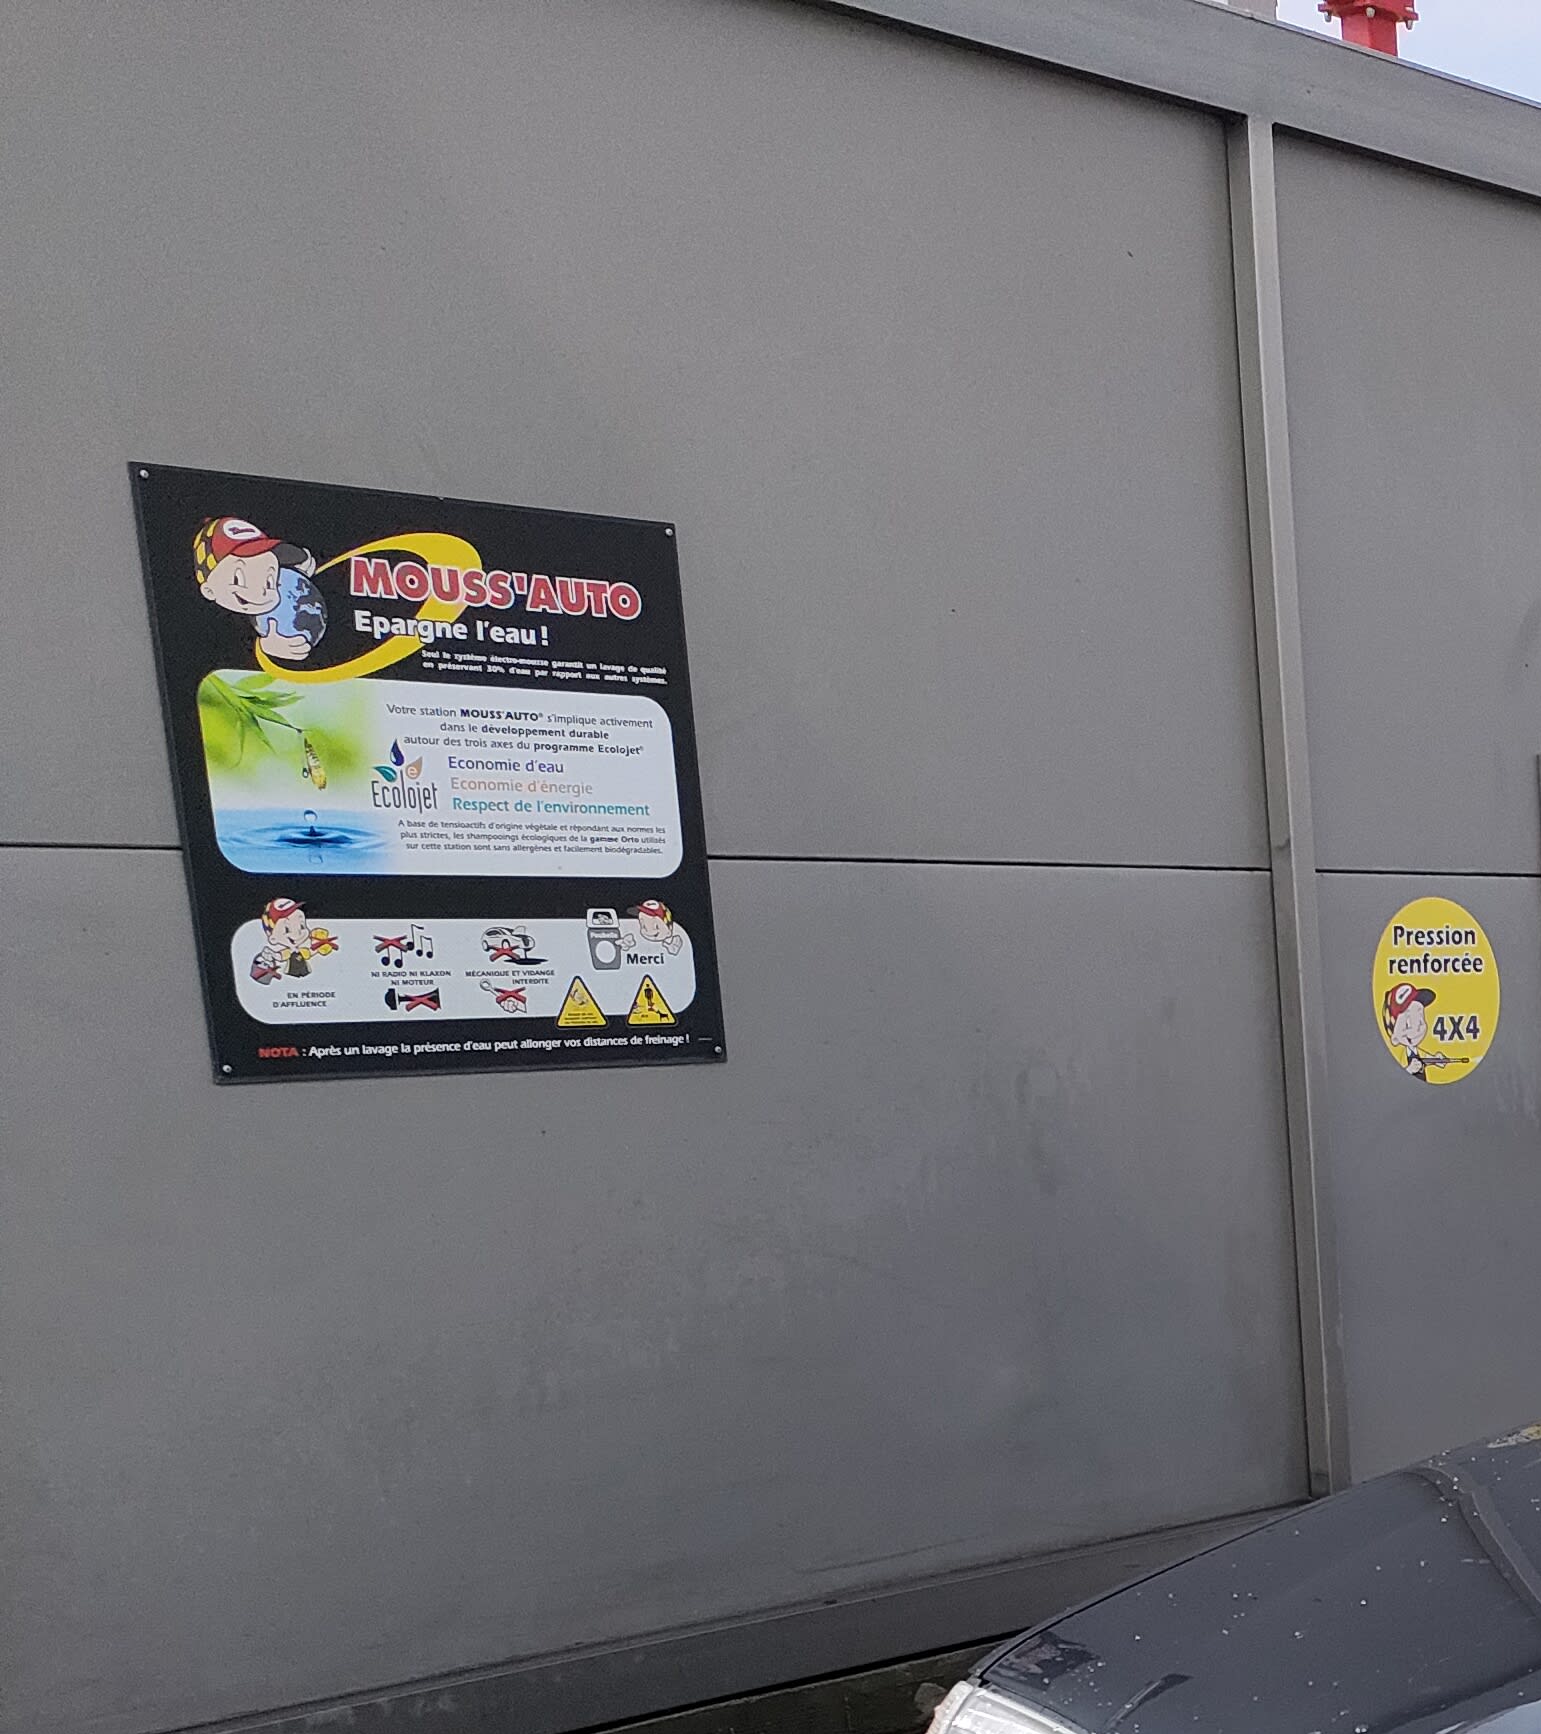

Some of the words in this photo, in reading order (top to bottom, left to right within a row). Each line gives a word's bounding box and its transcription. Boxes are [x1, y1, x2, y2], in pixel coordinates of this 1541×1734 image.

[350, 556, 642, 620] MOUSS'AUTO
[354, 609, 468, 644] Epargne
[552, 670, 582, 679] rapport
[600, 662, 625, 672] lavage
[386, 704, 416, 715] Votre
[420, 706, 456, 717] station
[547, 714, 597, 726] s'implique
[600, 716, 653, 728] activement
[440, 722, 465, 732] dans
[468, 724, 478, 732] le
[482, 724, 565, 738] développement
[569, 729, 609, 740] durable
[404, 736, 440, 745] autour
[443, 736, 460, 746] des
[464, 737, 488, 748] trois
[490, 740, 514, 749] axes
[516, 740, 530, 750] du
[534, 742, 594, 753] programme
[448, 756, 520, 772] Economie
[526, 758, 564, 773] d'eau
[371, 769, 438, 814] Ecolojet
[450, 776, 523, 792] Economie
[528, 780, 593, 796] d'énergie
[452, 797, 510, 814] Respect
[514, 799, 533, 812] de
[537, 800, 650, 816] l'environnement
[406, 820, 426, 828] base
[428, 820, 438, 828] de
[488, 822, 522, 832] d'origine
[570, 824, 608, 833] répondant
[400, 831, 417, 840] plus
[453, 832, 464, 840] les
[521, 834, 566, 843] écologiques
[569, 834, 578, 842] de
[1393, 925, 1476, 946] Pression
[626, 953, 664, 964] Merci
[1388, 953, 1483, 974] renforcée
[371, 970, 380, 978] NI
[382, 970, 408, 978] RADIO
[465, 968, 510, 978] MÉCANIQUE
[403, 978, 434, 986] MOTEUR
[288, 992, 299, 1000] EN
[302, 990, 336, 999] PÉRIODE
[273, 1000, 327, 1008] D'AFFLUENCE
[1432, 1015, 1480, 1041] 4X4
[258, 1047, 299, 1058] NOTA
[308, 1045, 341, 1059] Après
[362, 1044, 398, 1056] lavage
[400, 1042, 410, 1053] la
[414, 1042, 461, 1055] présence
[464, 1040, 492, 1051] d'eau
[494, 1040, 518, 1052] peut
[520, 1038, 562, 1050] allonger
[564, 1039, 581, 1048] vos
[583, 1036, 628, 1046] distances
[630, 1036, 642, 1045] de
[645, 1034, 684, 1046] freinage
